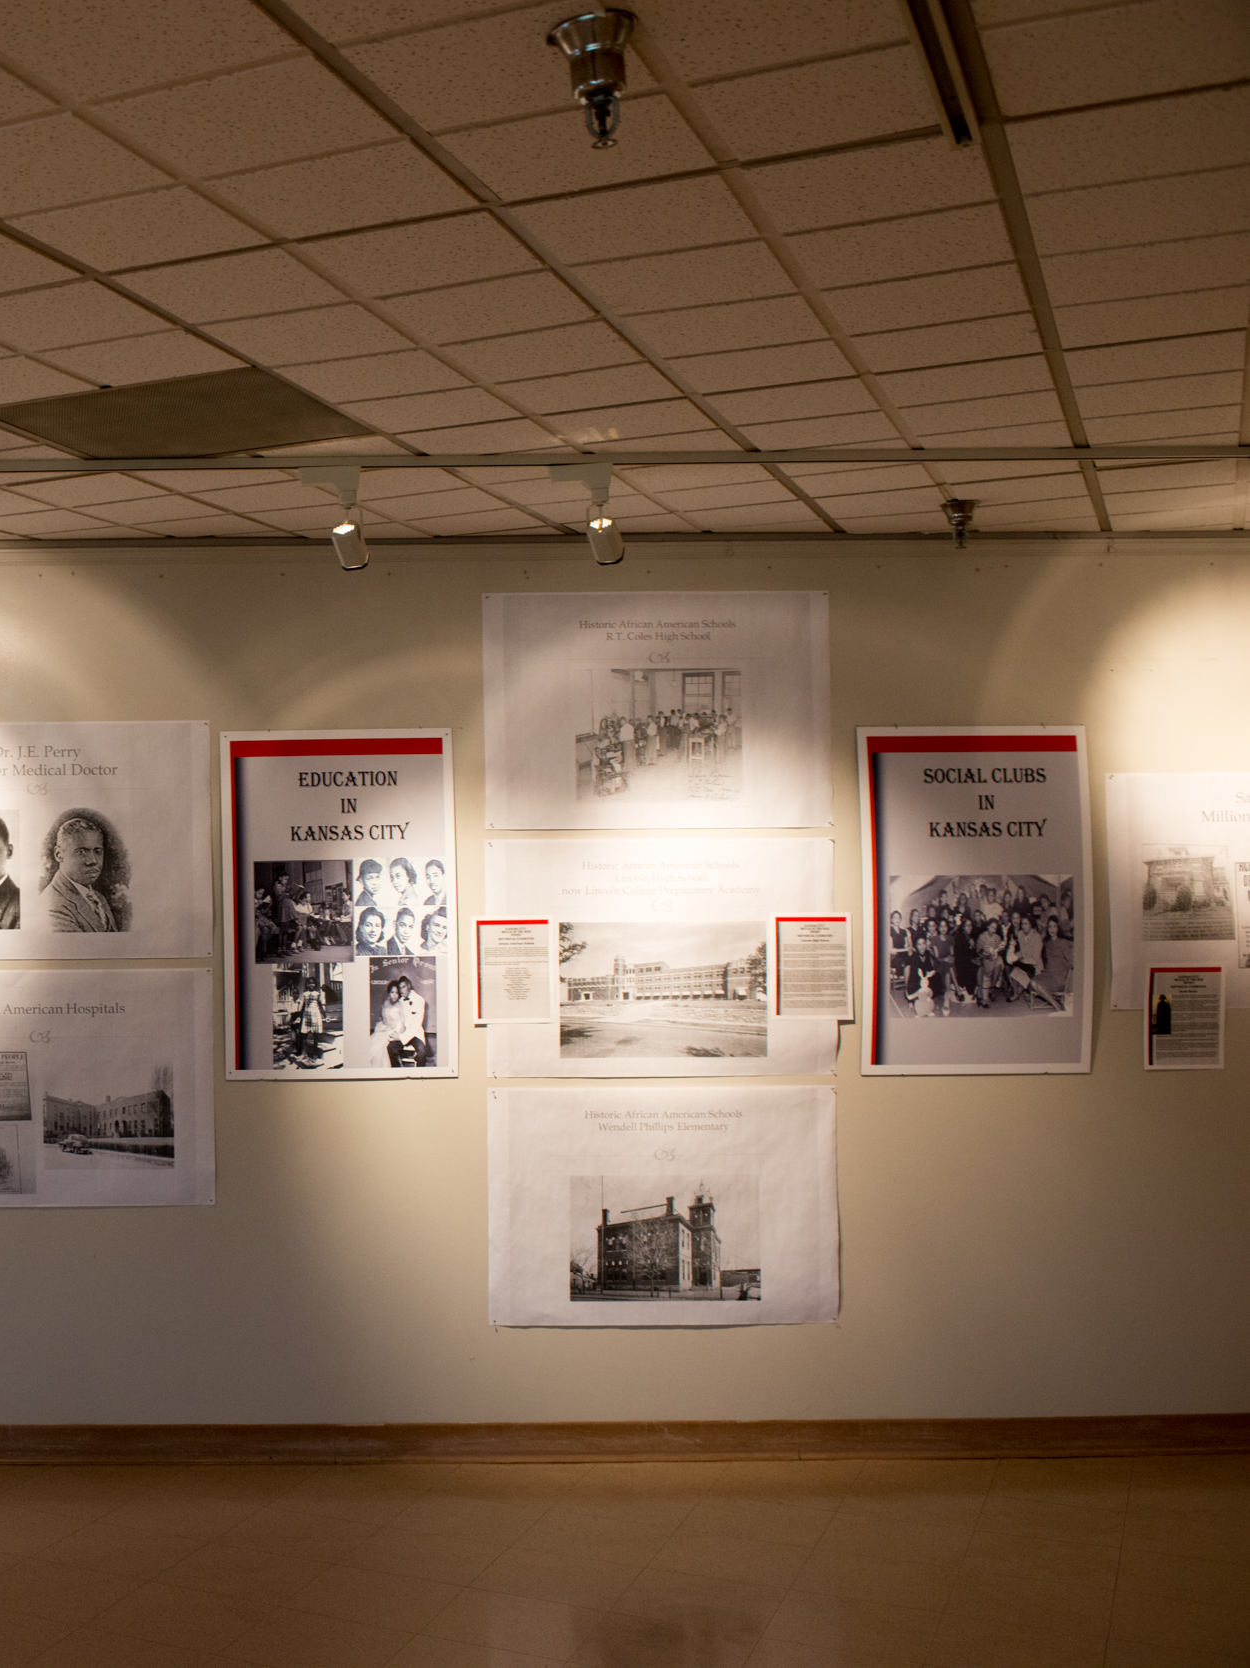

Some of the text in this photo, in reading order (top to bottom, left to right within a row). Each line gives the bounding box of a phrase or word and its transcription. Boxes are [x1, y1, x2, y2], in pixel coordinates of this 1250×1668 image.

[578, 619, 737, 629] Historic African American Schools
[606, 631, 711, 643] R.T. Coles High School
[17, 745, 40, 760] J.E.
[44, 745, 82, 761] Perry
[12, 763, 67, 776] Medical
[71, 763, 118, 776] Doctor
[923, 767, 1047, 784] SOCIAL CLUBS
[298, 770, 398, 787] EDUCATION
[340, 798, 357, 814] IN
[978, 794, 995, 810] IN
[290, 821, 410, 842] KANSAS CITY
[929, 818, 1048, 838] KANSAS CITY
[581, 860, 740, 871] Historic African American Schools
[614, 873, 708, 885] Lincoln High School
[561, 885, 761, 898] now Lincoln College Preparatory Academy
[382, 957, 410, 967] Senior
[412, 956, 436, 971] Prom
[2, 1003, 64, 1015] American
[66, 1002, 126, 1018] Hospitals
[584, 1109, 743, 1119] Historic African American Schools
[597, 1122, 729, 1133] Wendell Phillips Elementary
